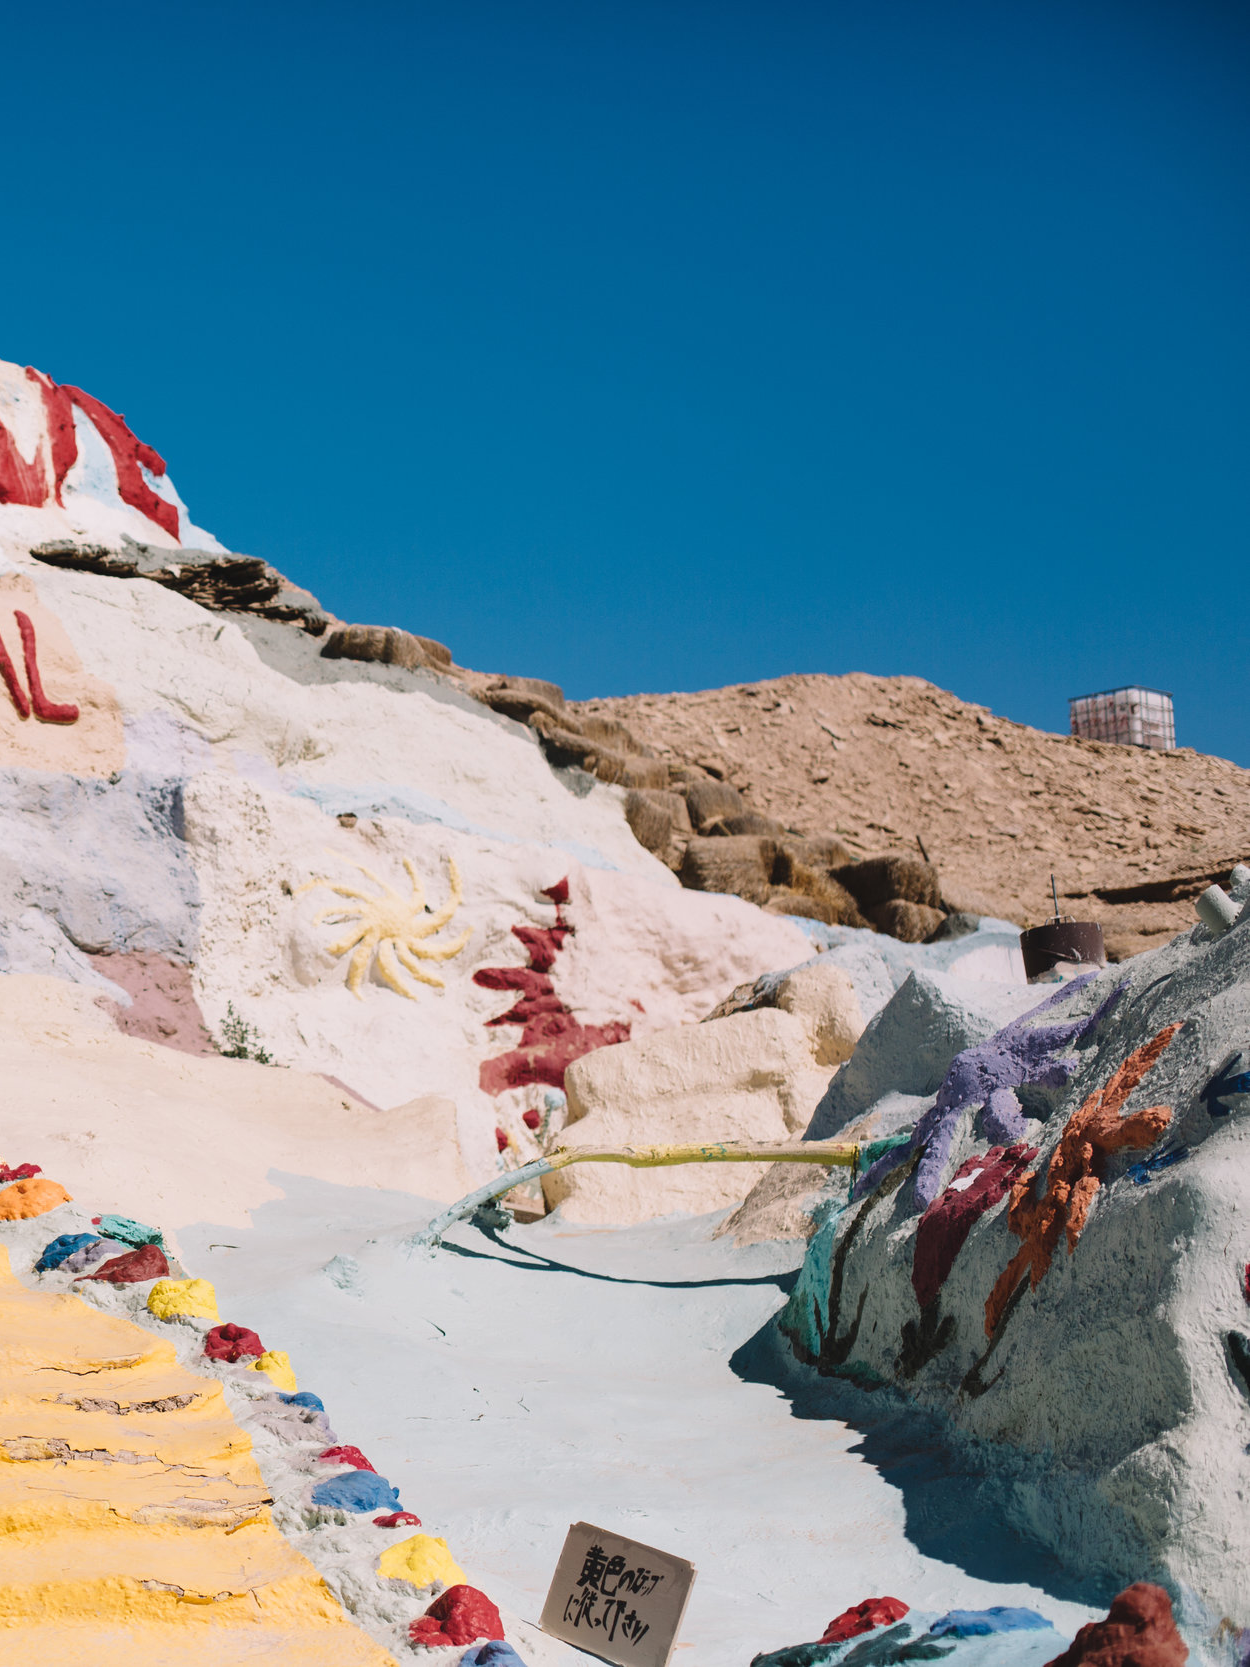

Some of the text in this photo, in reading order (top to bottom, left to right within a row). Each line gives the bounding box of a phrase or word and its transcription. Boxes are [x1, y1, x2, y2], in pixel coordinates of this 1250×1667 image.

[563, 1586, 650, 1647] に従って下さい
